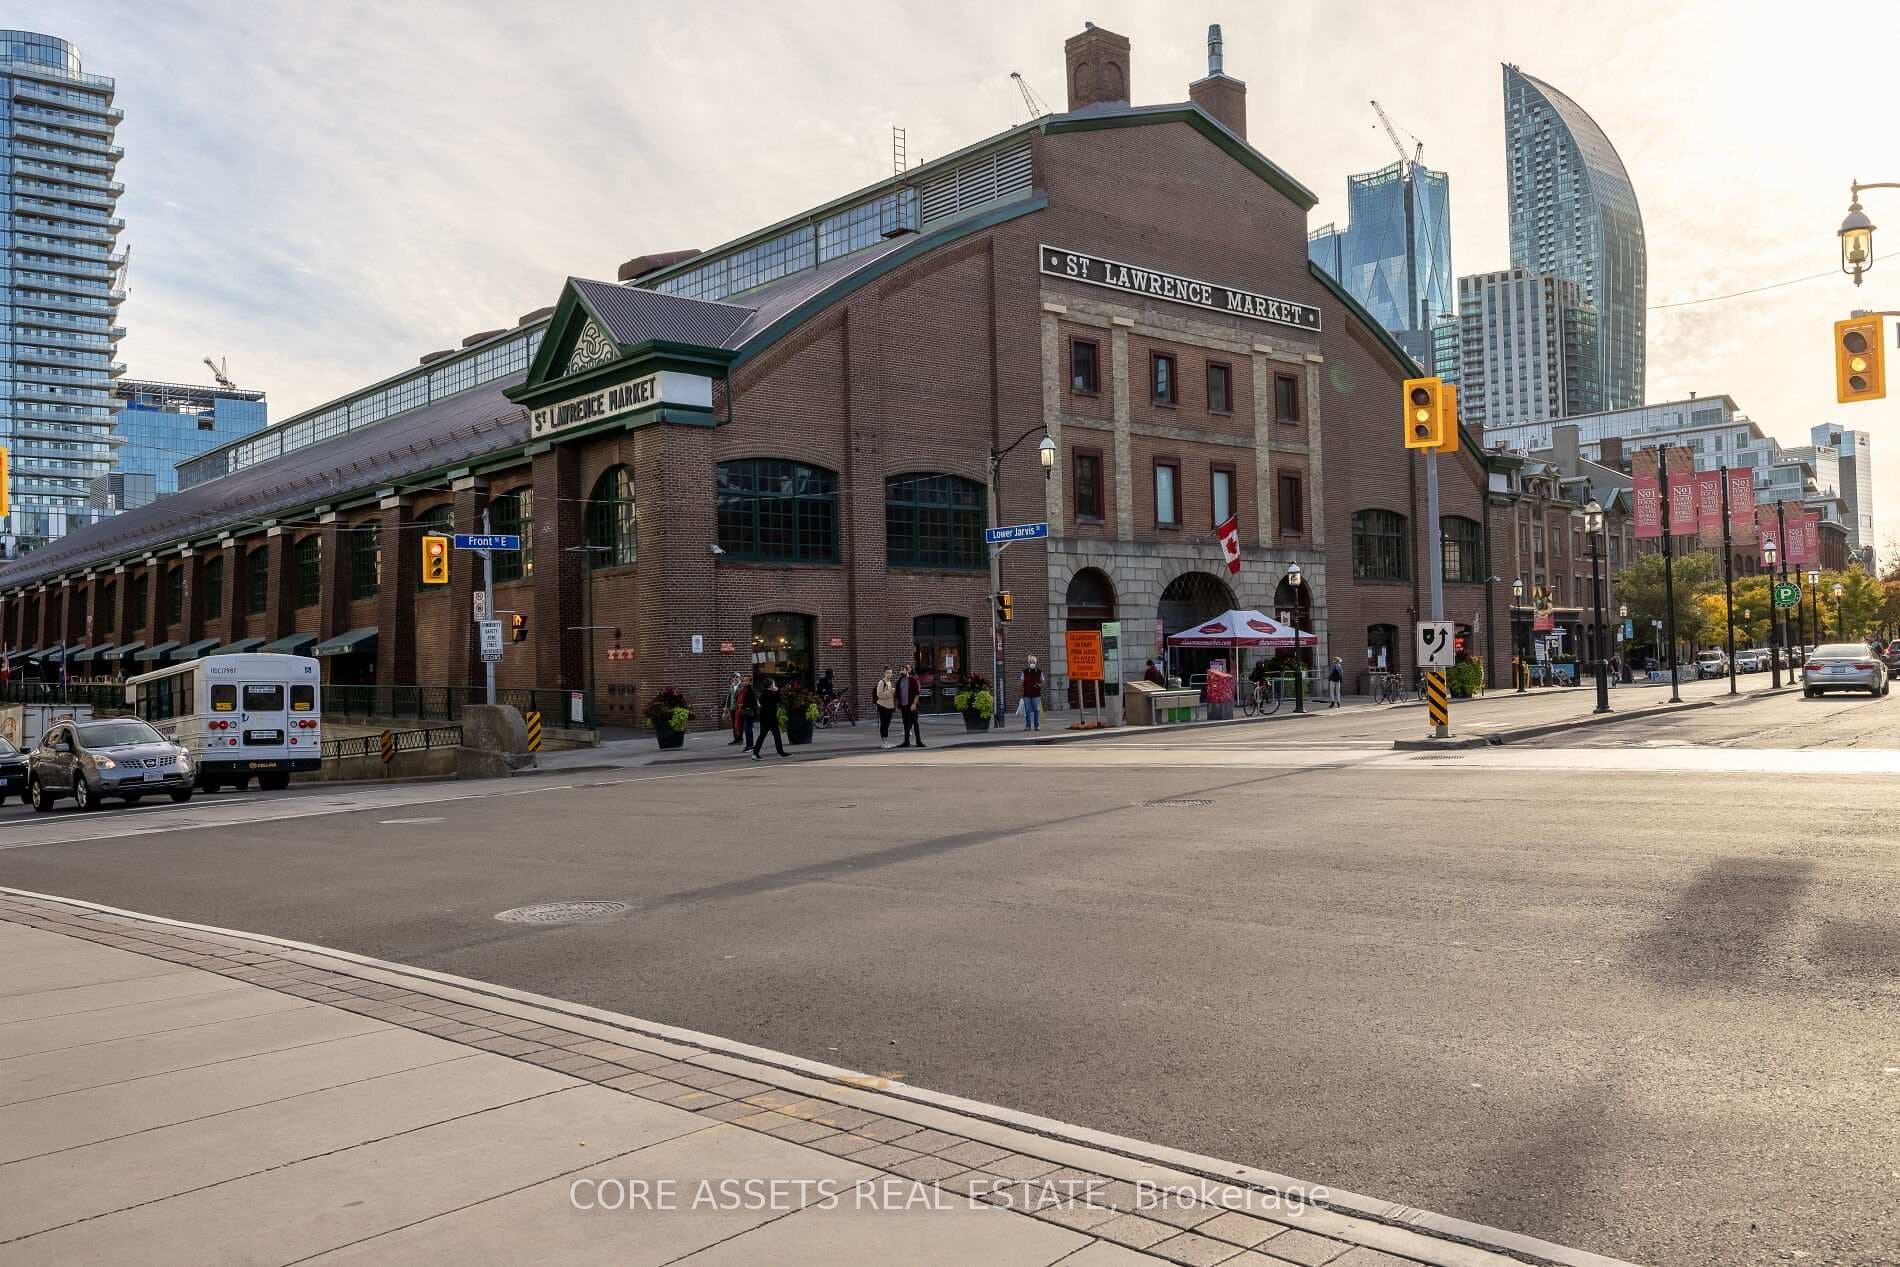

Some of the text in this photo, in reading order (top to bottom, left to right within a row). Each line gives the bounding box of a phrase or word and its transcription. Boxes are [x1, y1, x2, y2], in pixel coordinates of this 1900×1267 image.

[1104, 263, 1212, 305] LAWRENCE
[1226, 291, 1302, 324] MARKET
[550, 394, 605, 429] LAWRENCE
[608, 376, 656, 411] MARKET
[992, 529, 1013, 539] Lower
[1014, 526, 1035, 537] Jarvis
[468, 536, 493, 546] Front
[501, 537, 507, 546] E
[1780, 589, 1791, 599] P
[1073, 655, 1096, 664] CLOSED
